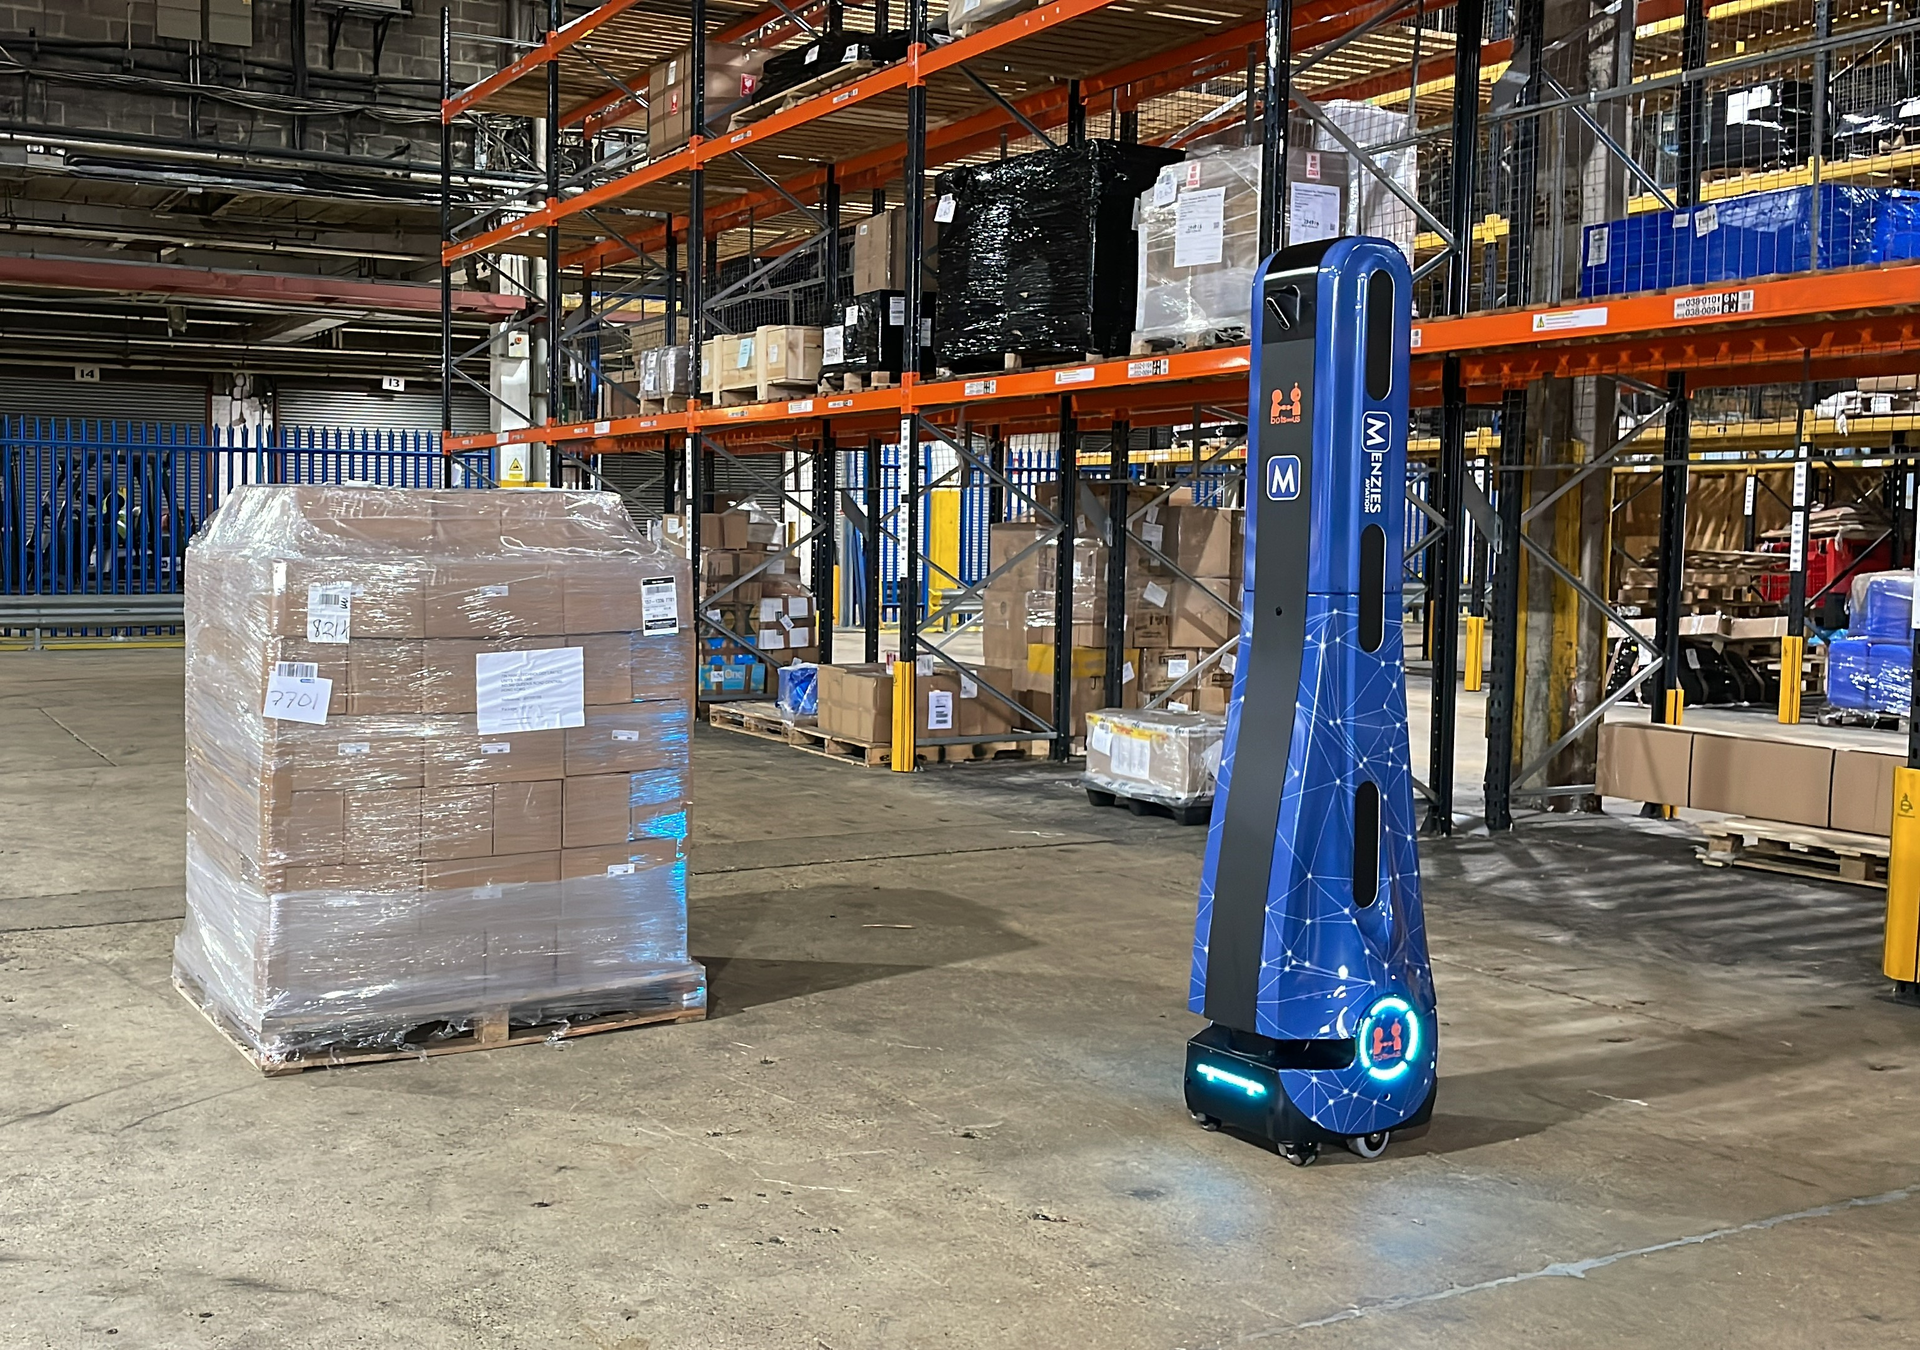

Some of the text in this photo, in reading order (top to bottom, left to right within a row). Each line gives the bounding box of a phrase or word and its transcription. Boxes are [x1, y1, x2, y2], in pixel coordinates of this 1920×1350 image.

[81, 369, 94, 378] 14
[389, 378, 400, 387] 13
[1271, 463, 1296, 494] M
[270, 690, 319, 710] 7701
